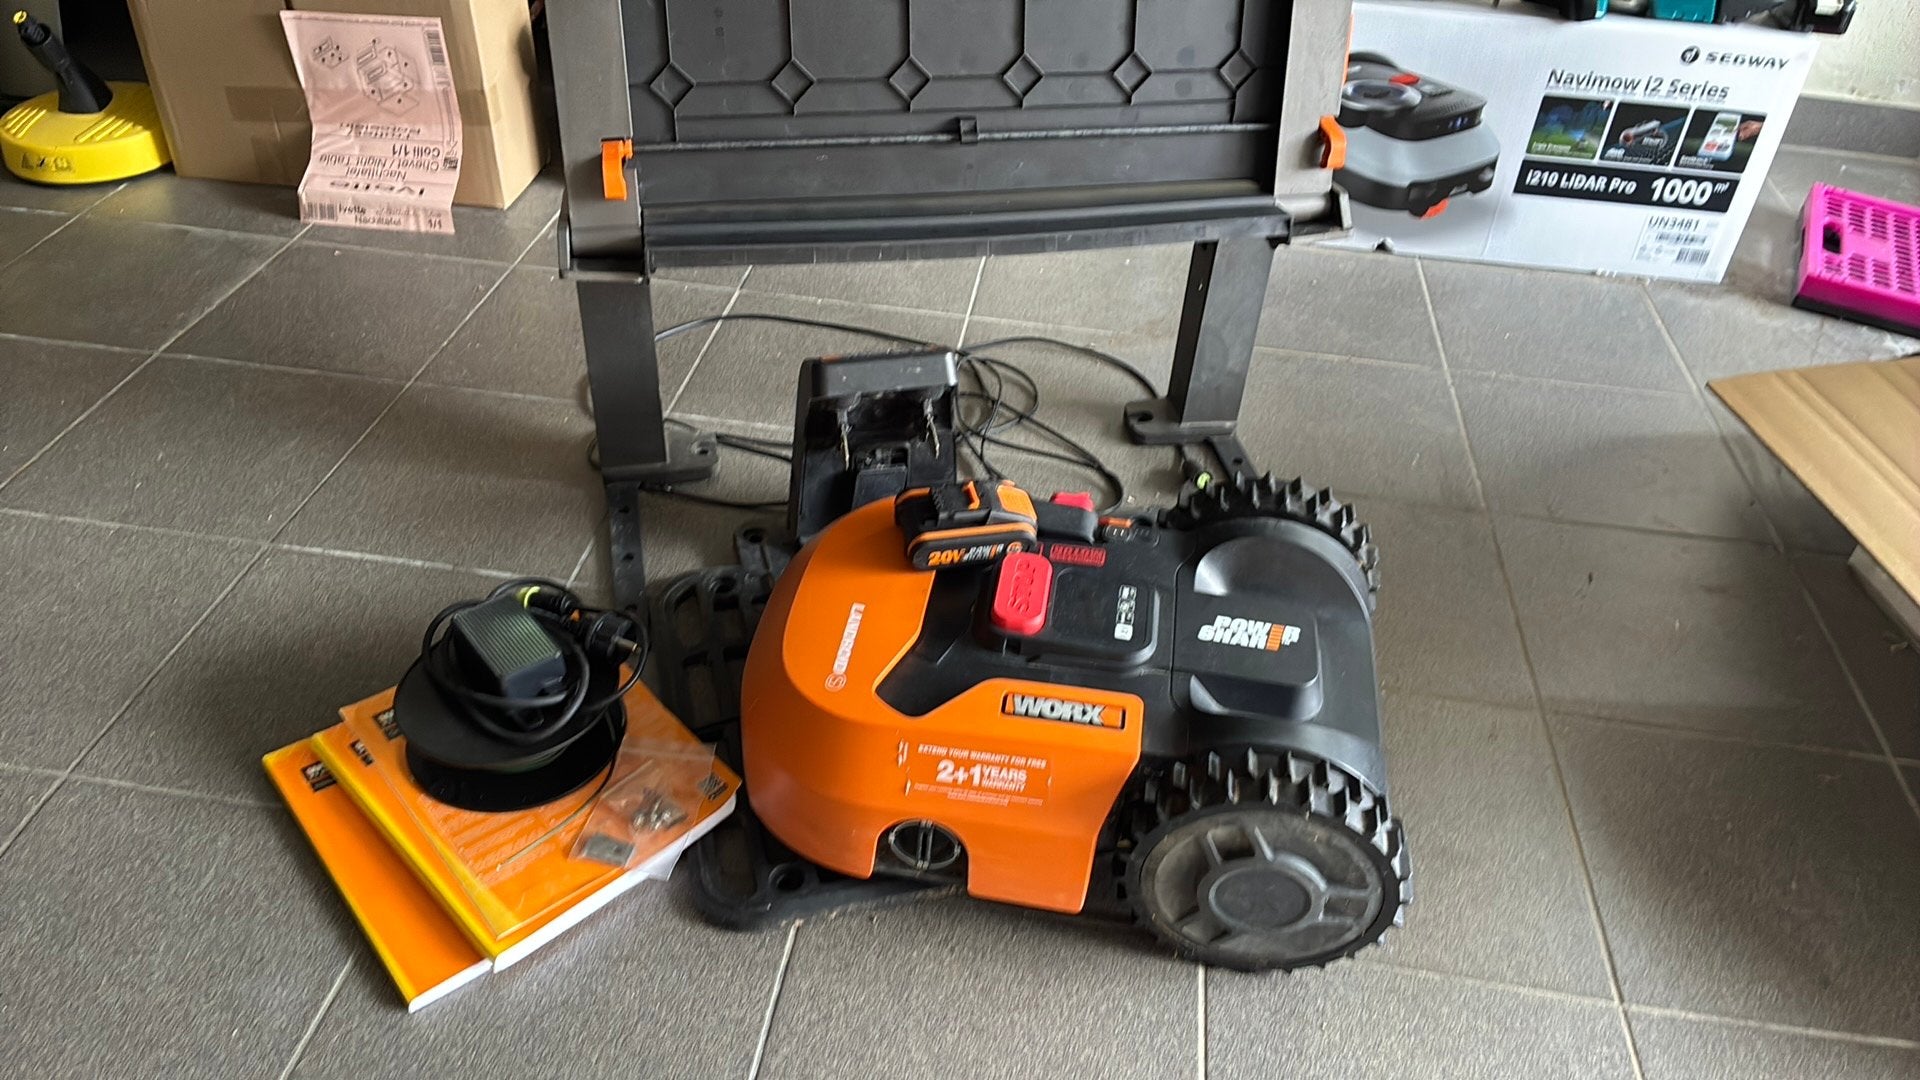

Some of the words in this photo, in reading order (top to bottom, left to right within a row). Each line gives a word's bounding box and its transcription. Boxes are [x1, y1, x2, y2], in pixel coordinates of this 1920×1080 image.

[1705, 51, 1790, 70] SEGWAY
[1547, 68, 1641, 91] Navimow
[1669, 79, 1730, 99] Series
[392, 143, 411, 157] 1/1
[413, 146, 440, 158] Colli
[320, 154, 351, 167] Table
[356, 156, 387, 169] Night
[1608, 177, 1637, 195] Pro
[1651, 177, 1713, 206] 1000
[1648, 216, 1700, 232] UN3481
[928, 547, 962, 567] 20V
[1013, 693, 1105, 727] WORX
[918, 743, 949, 757] EXTEND
[949, 747, 969, 759] YOUR
[969, 750, 1010, 763] WARRANTY
[1010, 755, 1027, 766] FOR
[1027, 758, 1048, 770] FREE
[935, 759, 982, 787] 2+1
[982, 765, 1027, 782] YEARS
